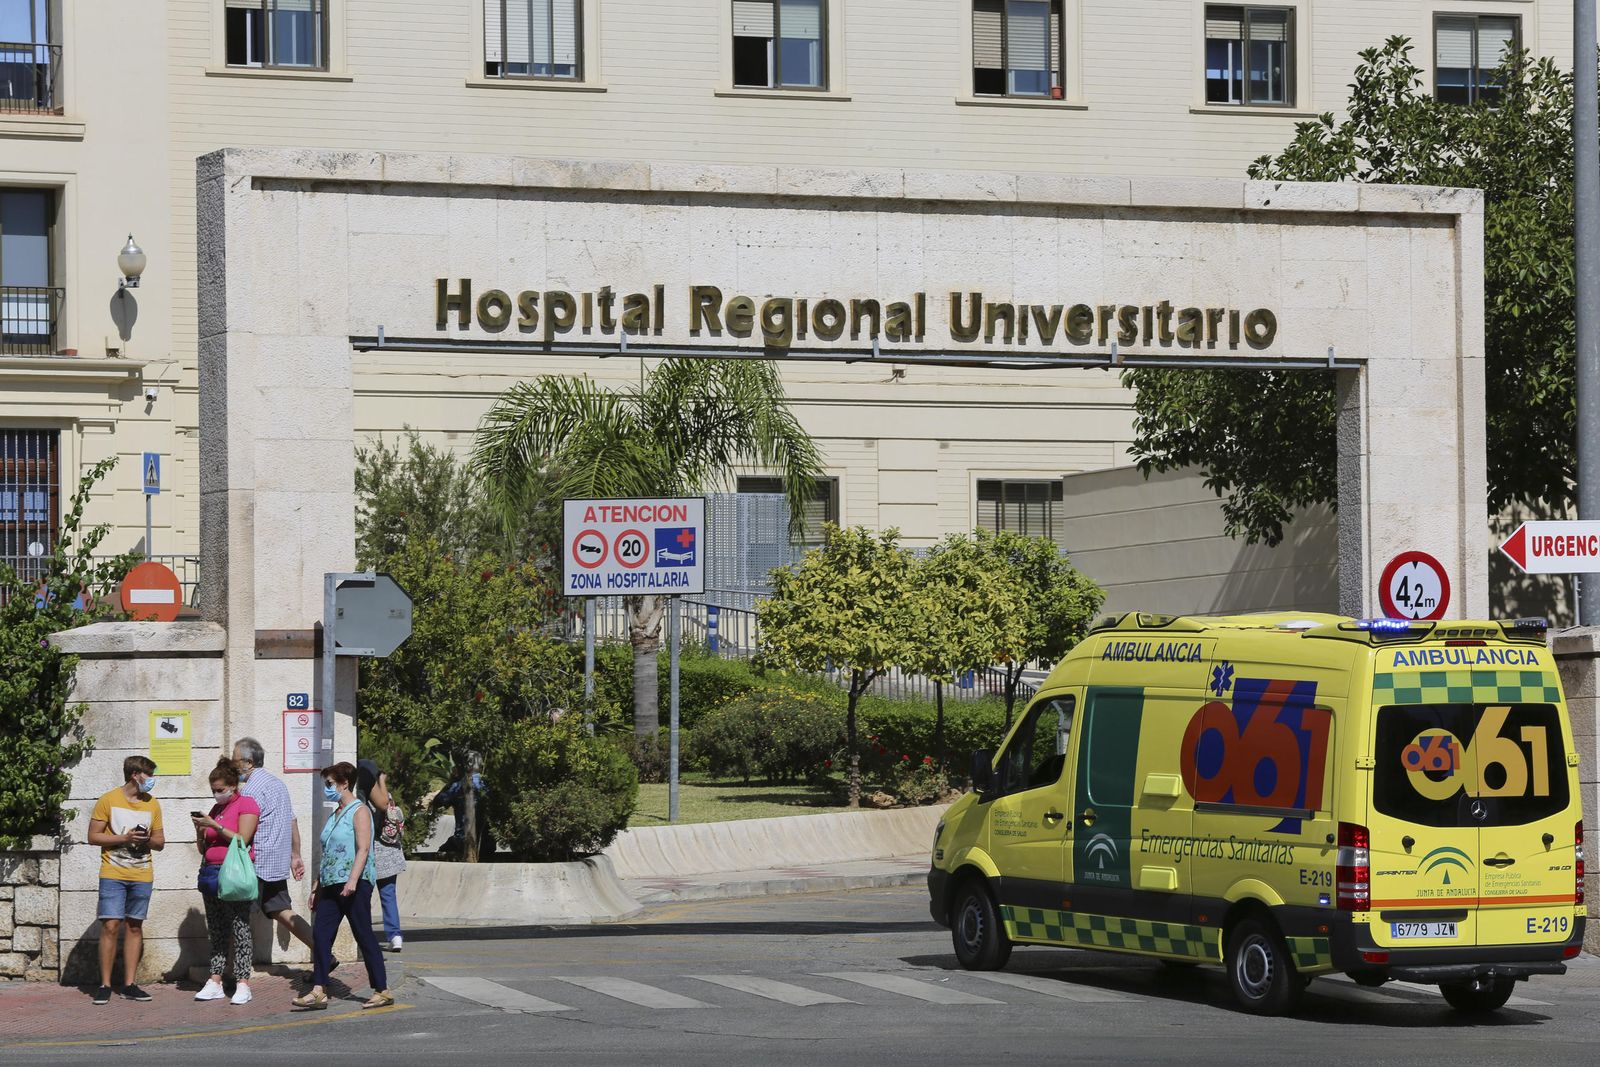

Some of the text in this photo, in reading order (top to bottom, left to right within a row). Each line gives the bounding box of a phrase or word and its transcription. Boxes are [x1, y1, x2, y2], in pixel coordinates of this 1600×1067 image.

[436, 278, 1278, 349] Hospital Regional Universitario
[583, 505, 687, 523] ATENCION
[622, 540, 641, 557] 20
[1532, 535, 1600, 556] URGENC
[571, 572, 690, 589] ZONA HOSPITALARIA
[1102, 641, 1202, 663] AMBULANCIA
[1393, 649, 1540, 667] AMBULANCIA
[289, 695, 304, 706] 82
[1180, 679, 1332, 811] 061
[1401, 736, 1460, 772] 061
[1140, 829, 1294, 865] Emergencias Sanitarias
[1300, 869, 1332, 887] E-219
[1416, 889, 1434, 897] JUNTA
[1446, 888, 1477, 896] ANDALUCIA
[1398, 923, 1455, 936] 6779 JZW
[1527, 916, 1568, 933] E-219
